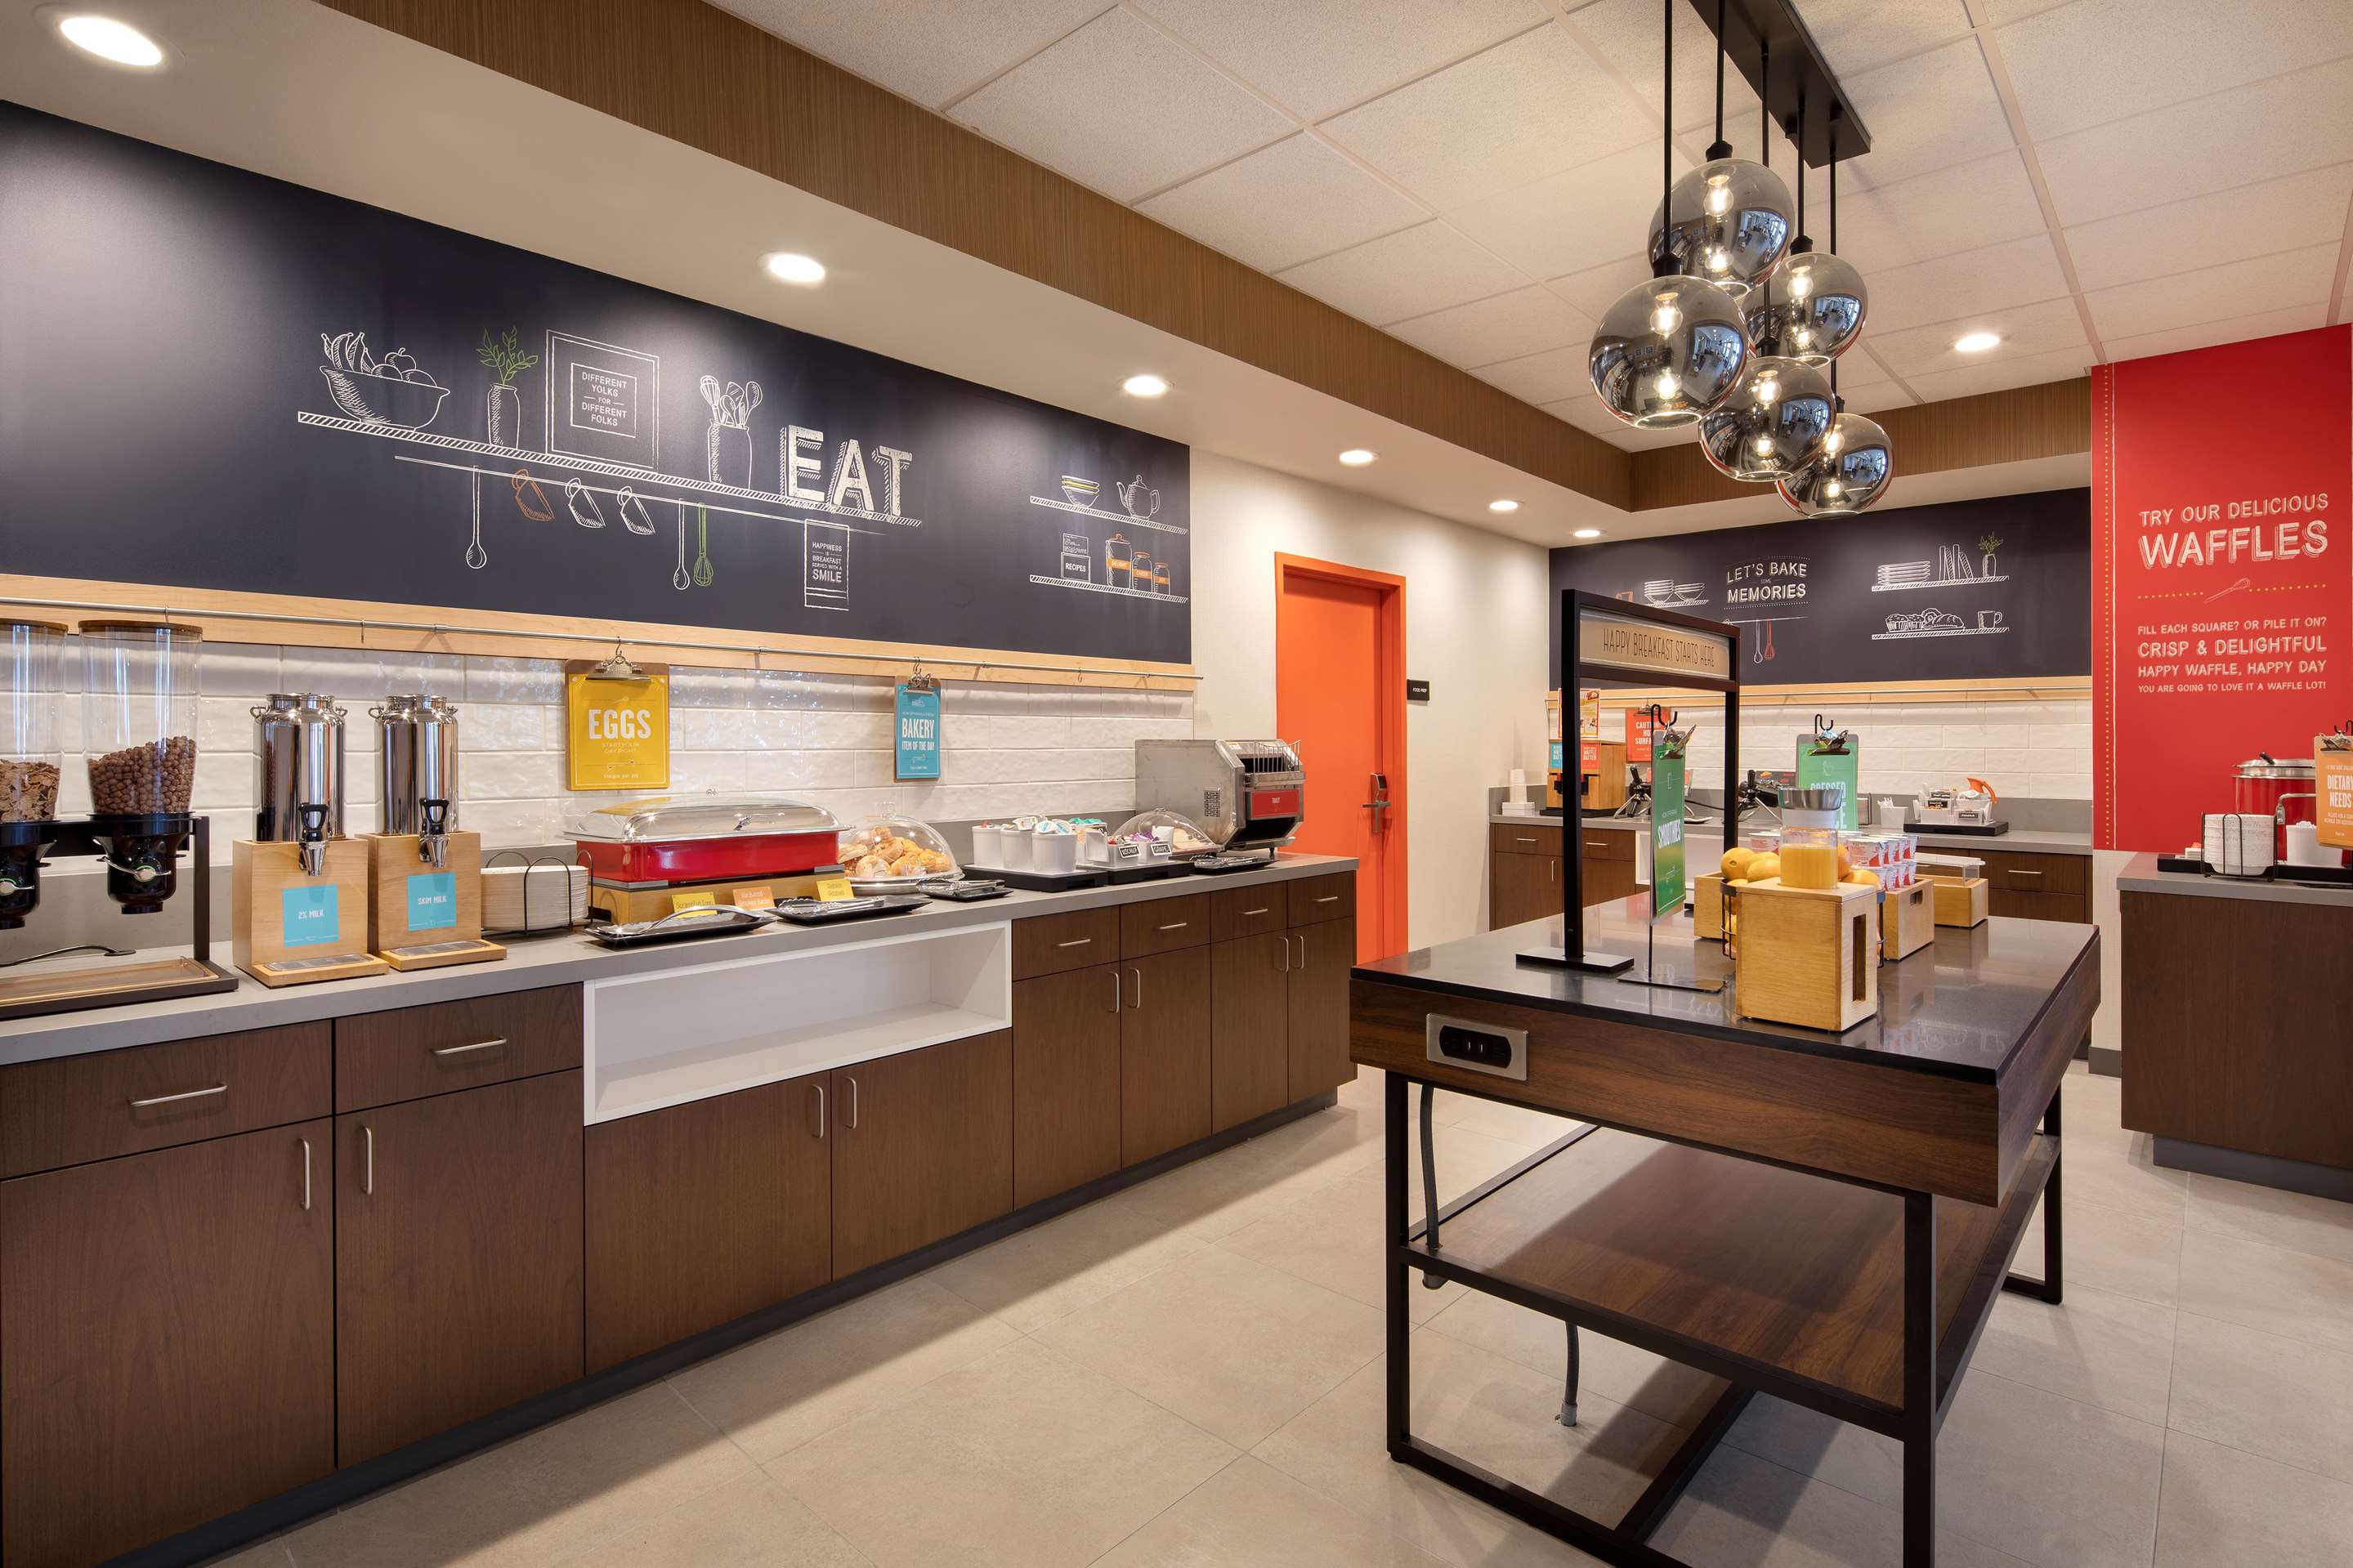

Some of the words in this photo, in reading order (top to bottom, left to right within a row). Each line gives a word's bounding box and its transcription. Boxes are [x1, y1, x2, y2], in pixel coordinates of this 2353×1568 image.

[582, 372, 627, 389] DIFFERENT
[592, 384, 619, 397] YOLKS
[582, 402, 627, 418] DIFFERENT
[591, 414, 618, 426] FOLKS
[781, 425, 913, 517] EAT
[2139, 509, 2173, 527] TRY
[2181, 504, 2221, 523] OUR
[2228, 493, 2328, 519] DELICIOUS
[812, 542, 843, 552] HAPPINESS
[2138, 520, 2328, 570] WAFFLES
[812, 555, 842, 565] BREAKFAST
[1065, 562, 1086, 572] RECIPES
[1111, 559, 1127, 569] DELIGHT
[812, 569, 842, 583] SMILE
[1726, 563, 1764, 583] LET'S
[1769, 561, 1807, 577] BAKE
[1727, 583, 1806, 603] MEMORIES
[2138, 626, 2156, 635] FILL
[2160, 623, 2187, 634] EACH
[2191, 621, 2239, 632] SQUARE?
[2244, 620, 2259, 630] OR
[2263, 619, 2286, 629] PILE
[2290, 618, 2301, 628] IT
[2305, 616, 2327, 628] ON?
[1604, 628, 1631, 654] HAPPY
[1634, 632, 1674, 660] BREAKFAST
[1675, 640, 1698, 664] STARTS
[1700, 645, 1715, 667] HERE
[2138, 641, 2189, 658] CRISP
[2196, 640, 2208, 655] &
[2214, 635, 2327, 654] DELIGHTFUL
[2137, 664, 2180, 677] HAPPY
[2185, 663, 2242, 677] WAFFLE,
[2248, 661, 2293, 675] HAPPY
[2298, 659, 2327, 674] DAY
[2138, 685, 2154, 693] YOU
[2158, 684, 2174, 692] ARE
[2177, 683, 2204, 692] GOING
[2208, 683, 2218, 691] TO
[2221, 683, 2243, 691] LOVE
[2257, 682, 2264, 690] A
[2267, 681, 2302, 690] WAFFLE
[2306, 681, 2327, 690] LOT!
[588, 708, 652, 739] EGGS
[901, 718, 935, 739] BAKERY
[901, 740, 912, 750] ITEM
[913, 741, 919, 750] OF
[919, 741, 927, 750] THE
[2329, 792, 2351, 808] NEEDS
[1657, 819, 1681, 849] SMOOTHIES
[1121, 847, 1138, 855] KETCHUP
[1153, 845, 1169, 853] GRAPE
[418, 896, 432, 905] SKIM
[433, 896, 447, 904] MILK
[298, 910, 308, 920] 2%
[309, 909, 324, 918] MILK
